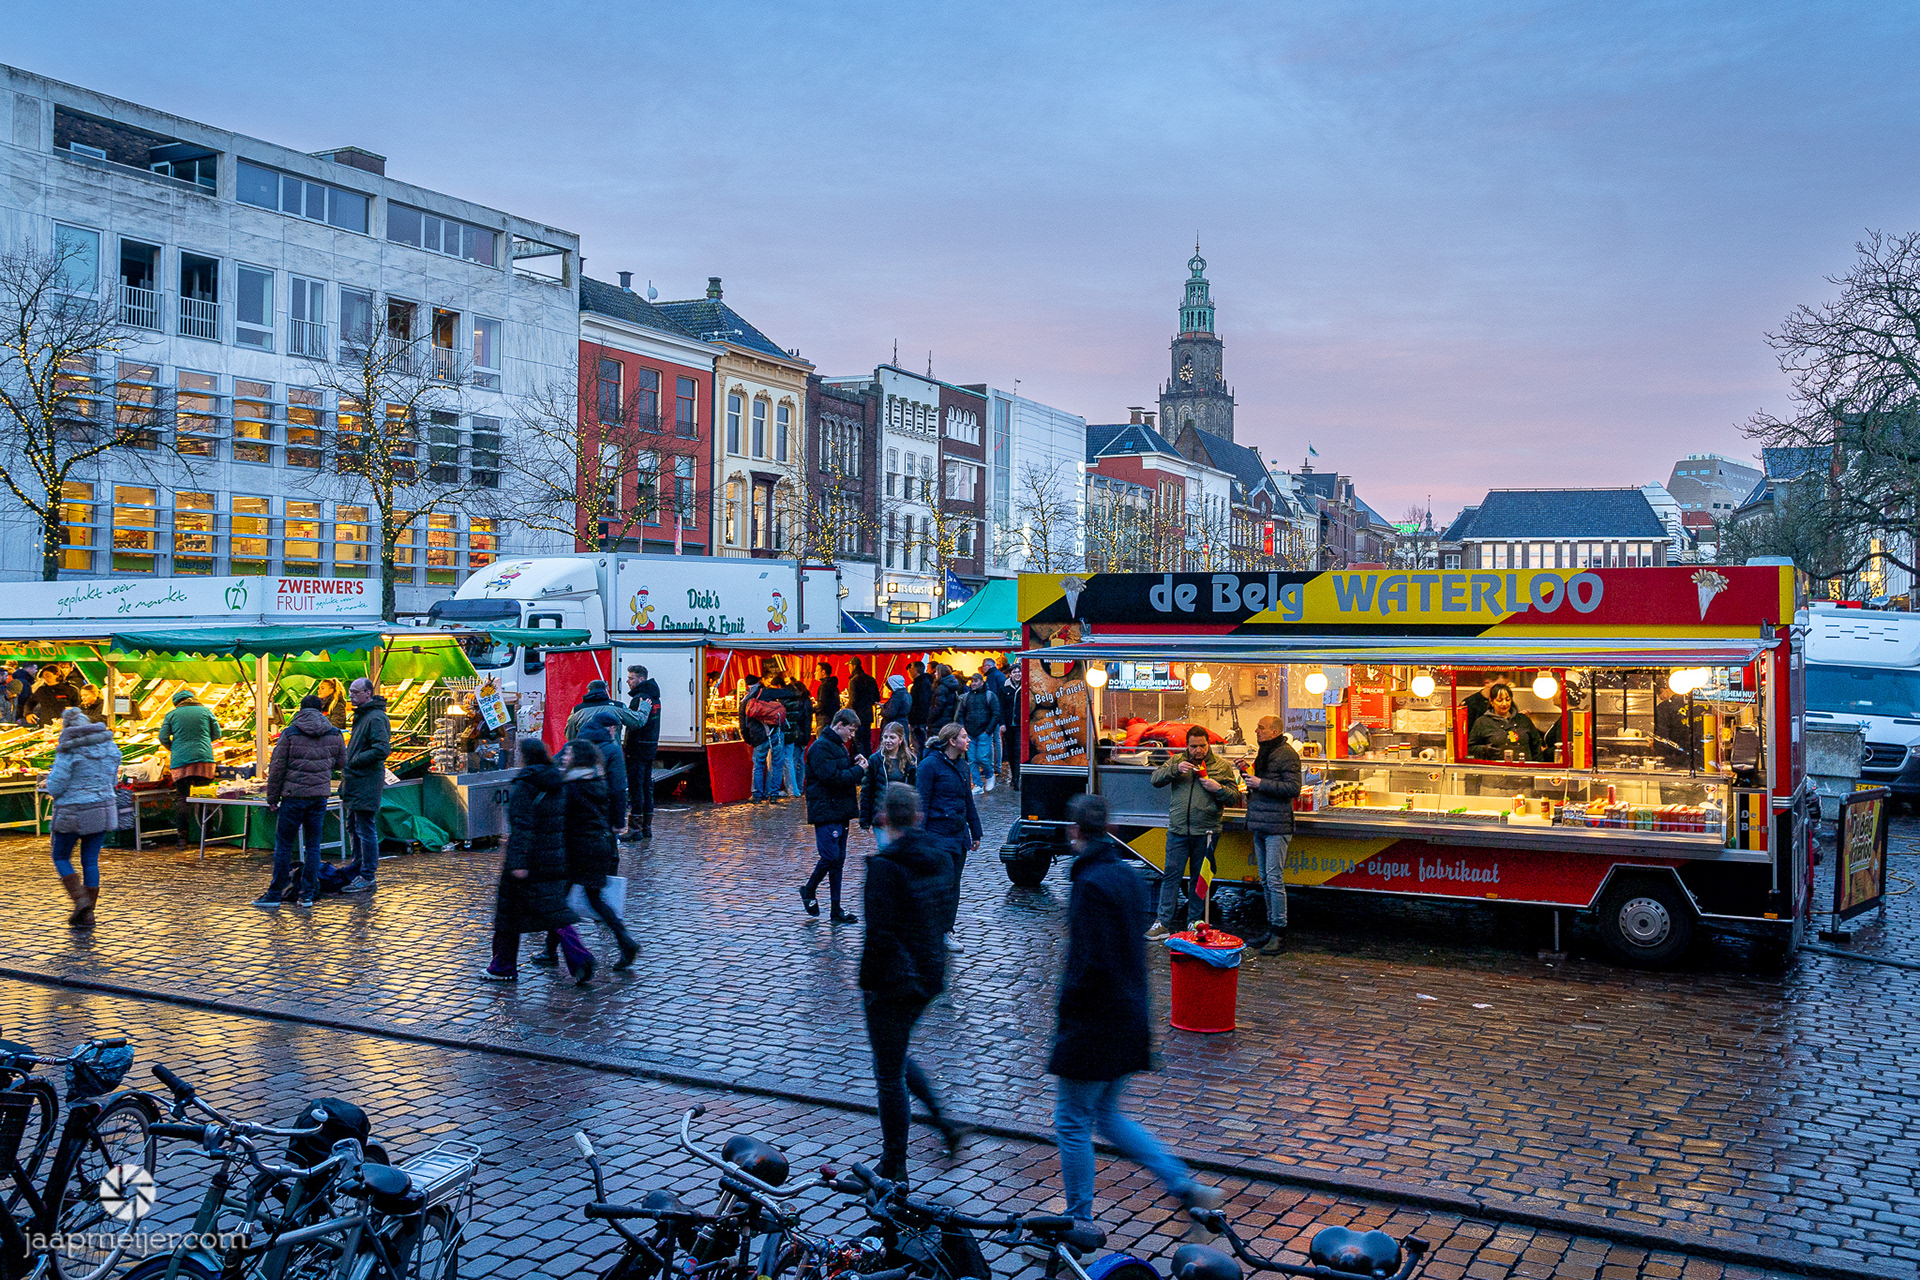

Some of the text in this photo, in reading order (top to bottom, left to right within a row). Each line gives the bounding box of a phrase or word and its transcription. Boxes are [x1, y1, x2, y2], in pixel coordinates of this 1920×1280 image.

[1074, 461, 1085, 557] Bershka
[277, 579, 364, 595] ZWERWER'S
[57, 583, 137, 616] geplukt voor
[117, 597, 132, 614] de
[277, 596, 315, 611] FRUIT
[686, 588, 720, 610] Dick's
[1149, 573, 1604, 621] de Belg WATERLOO
[708, 615, 716, 632] &
[719, 615, 746, 634] Fruit
[1035, 681, 1085, 704] Belg of niet!
[1033, 715, 1080, 733] familie Waterloo
[1064, 726, 1080, 736] verse
[1045, 738, 1078, 752] Biologische
[1045, 746, 1085, 763] Vlaamse Friet
[1740, 809, 1757, 819] De
[1740, 822, 1768, 834] Belg
[1368, 857, 1411, 881] eigen
[1419, 857, 1500, 884] fabrikaat
